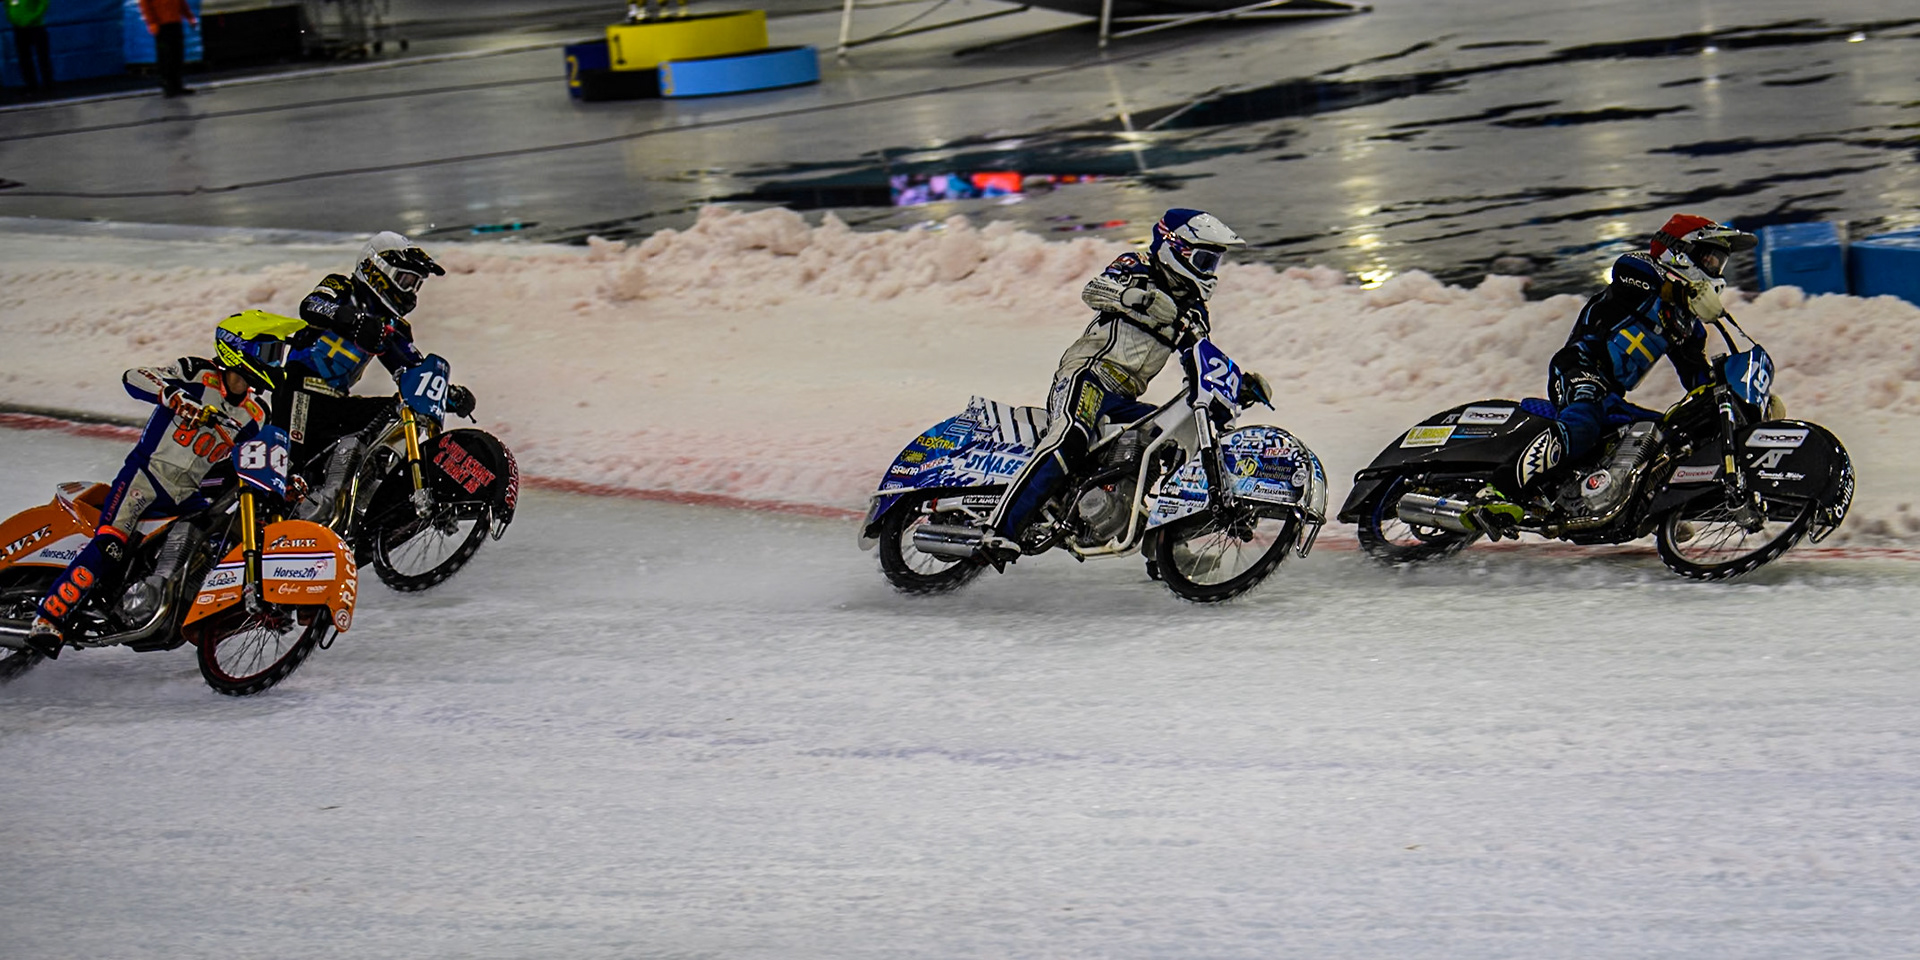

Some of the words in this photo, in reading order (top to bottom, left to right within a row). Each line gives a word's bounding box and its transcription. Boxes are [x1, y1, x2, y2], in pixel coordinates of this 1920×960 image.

[612, 33, 629, 66] 1
[566, 55, 583, 88] 2
[217, 327, 248, 351] 00%
[415, 371, 449, 406] 19
[43, 565, 95, 618] 800
